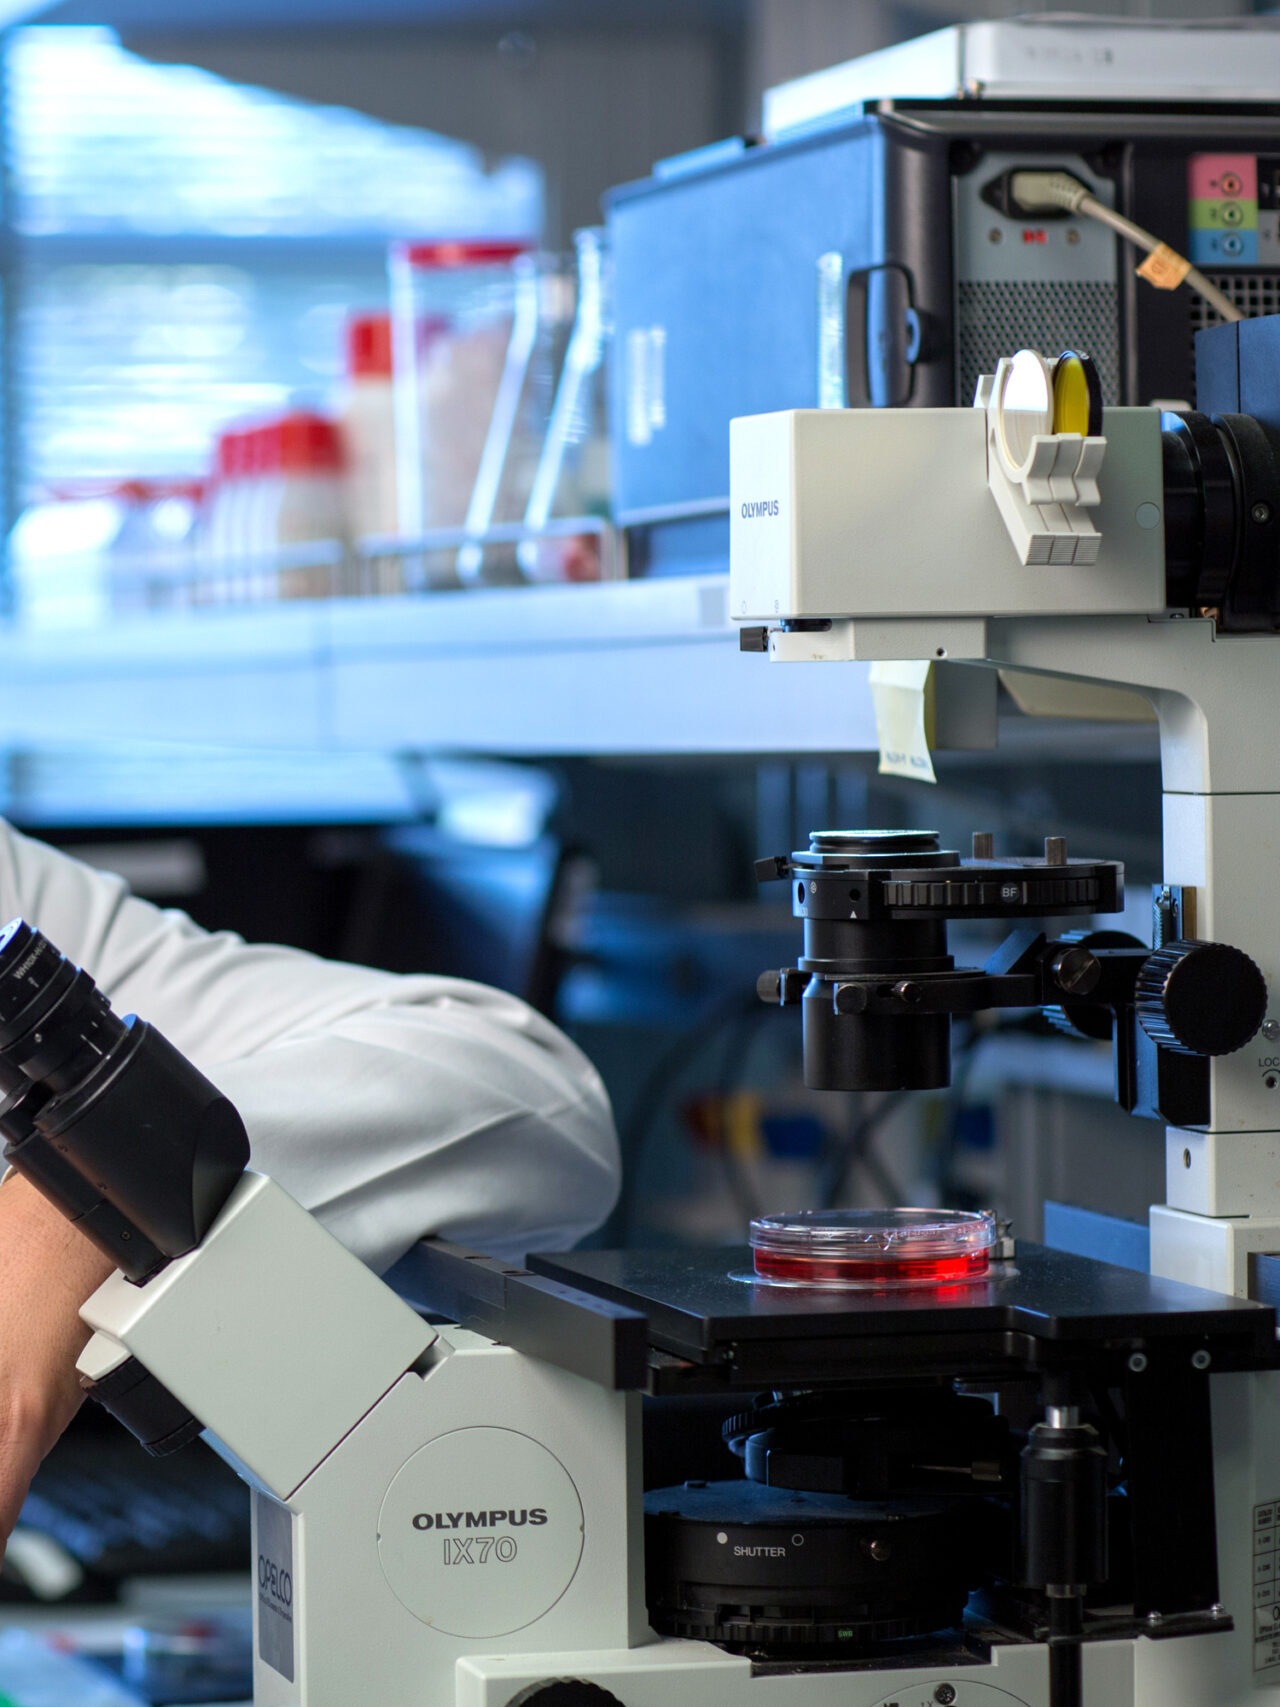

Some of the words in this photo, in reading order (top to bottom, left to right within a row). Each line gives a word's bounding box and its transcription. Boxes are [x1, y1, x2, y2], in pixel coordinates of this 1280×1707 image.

[741, 499, 780, 519] OLYMPUS
[1002, 887, 1018, 897] BF
[412, 1508, 548, 1531] OLYMPUS
[443, 1536, 518, 1565] IX70
[734, 1545, 786, 1557] SHUTTER
[258, 1554, 293, 1607] OPELCO
